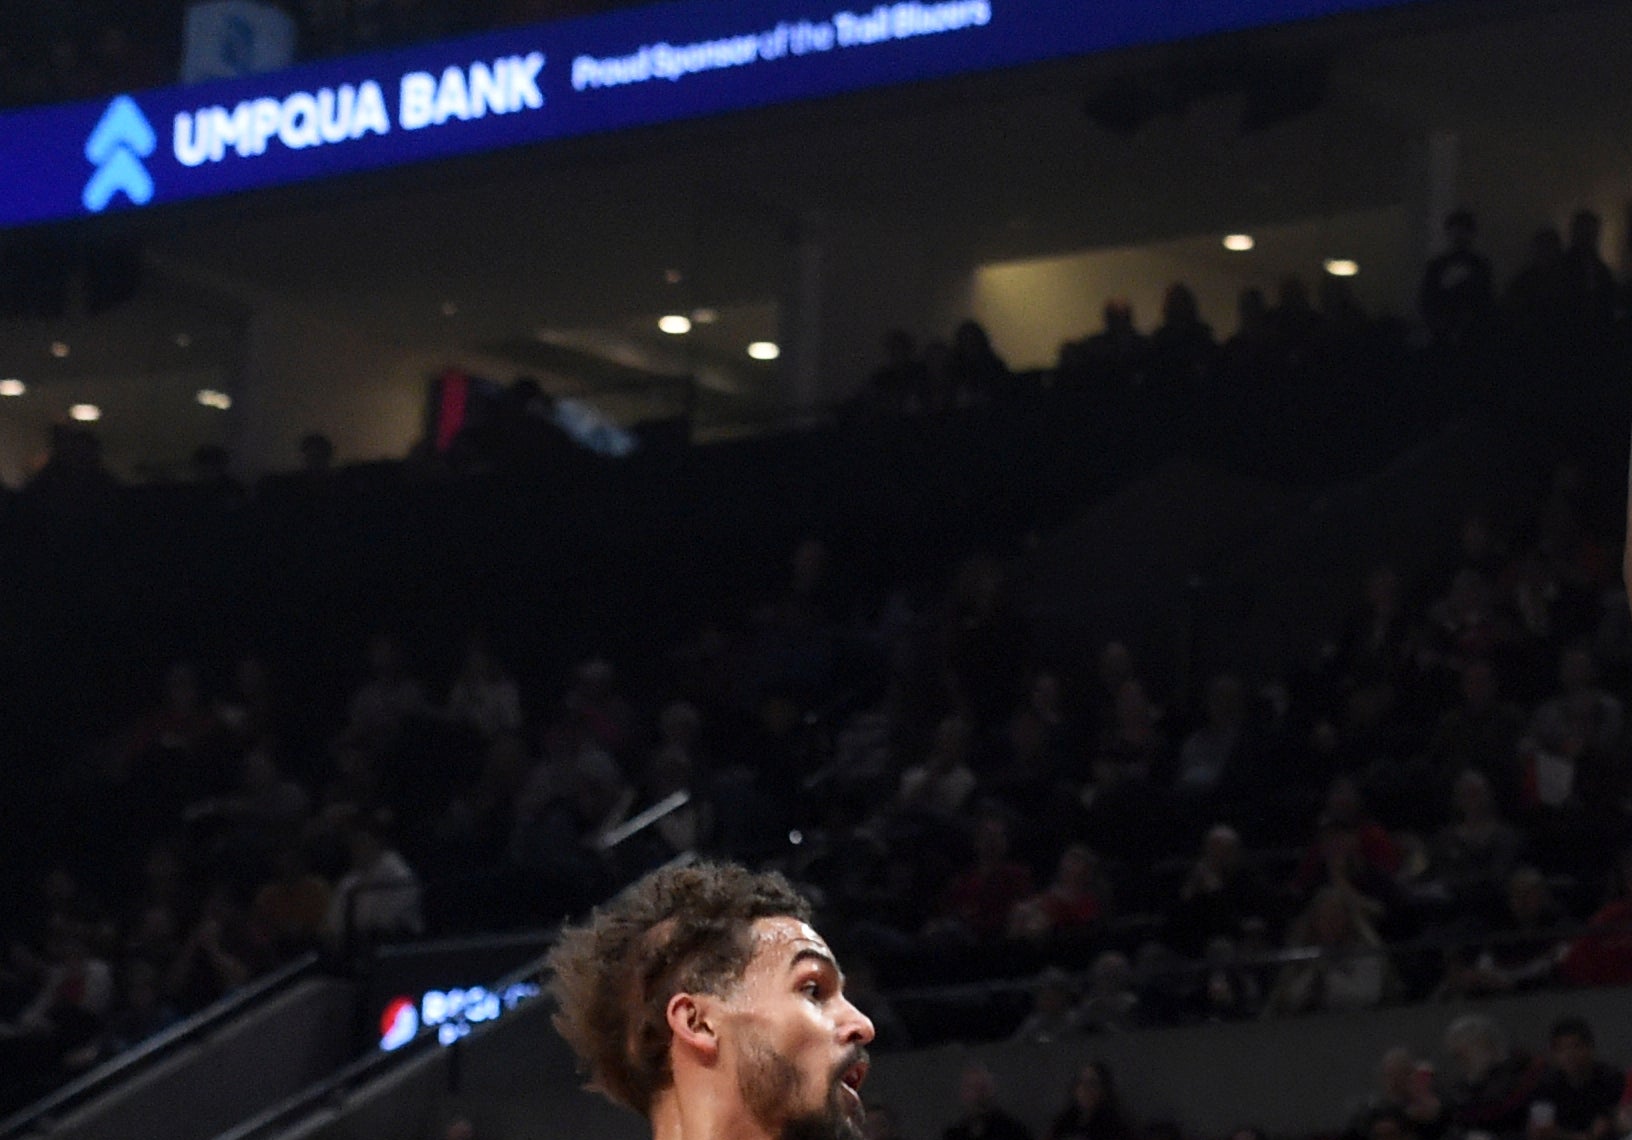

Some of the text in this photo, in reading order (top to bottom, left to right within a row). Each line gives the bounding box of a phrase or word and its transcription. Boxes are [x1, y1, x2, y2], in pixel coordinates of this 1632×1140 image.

[572, 0, 991, 90] Proud Sponsor of the Trail Blazers
[173, 51, 546, 167] UMPQUA BANK
